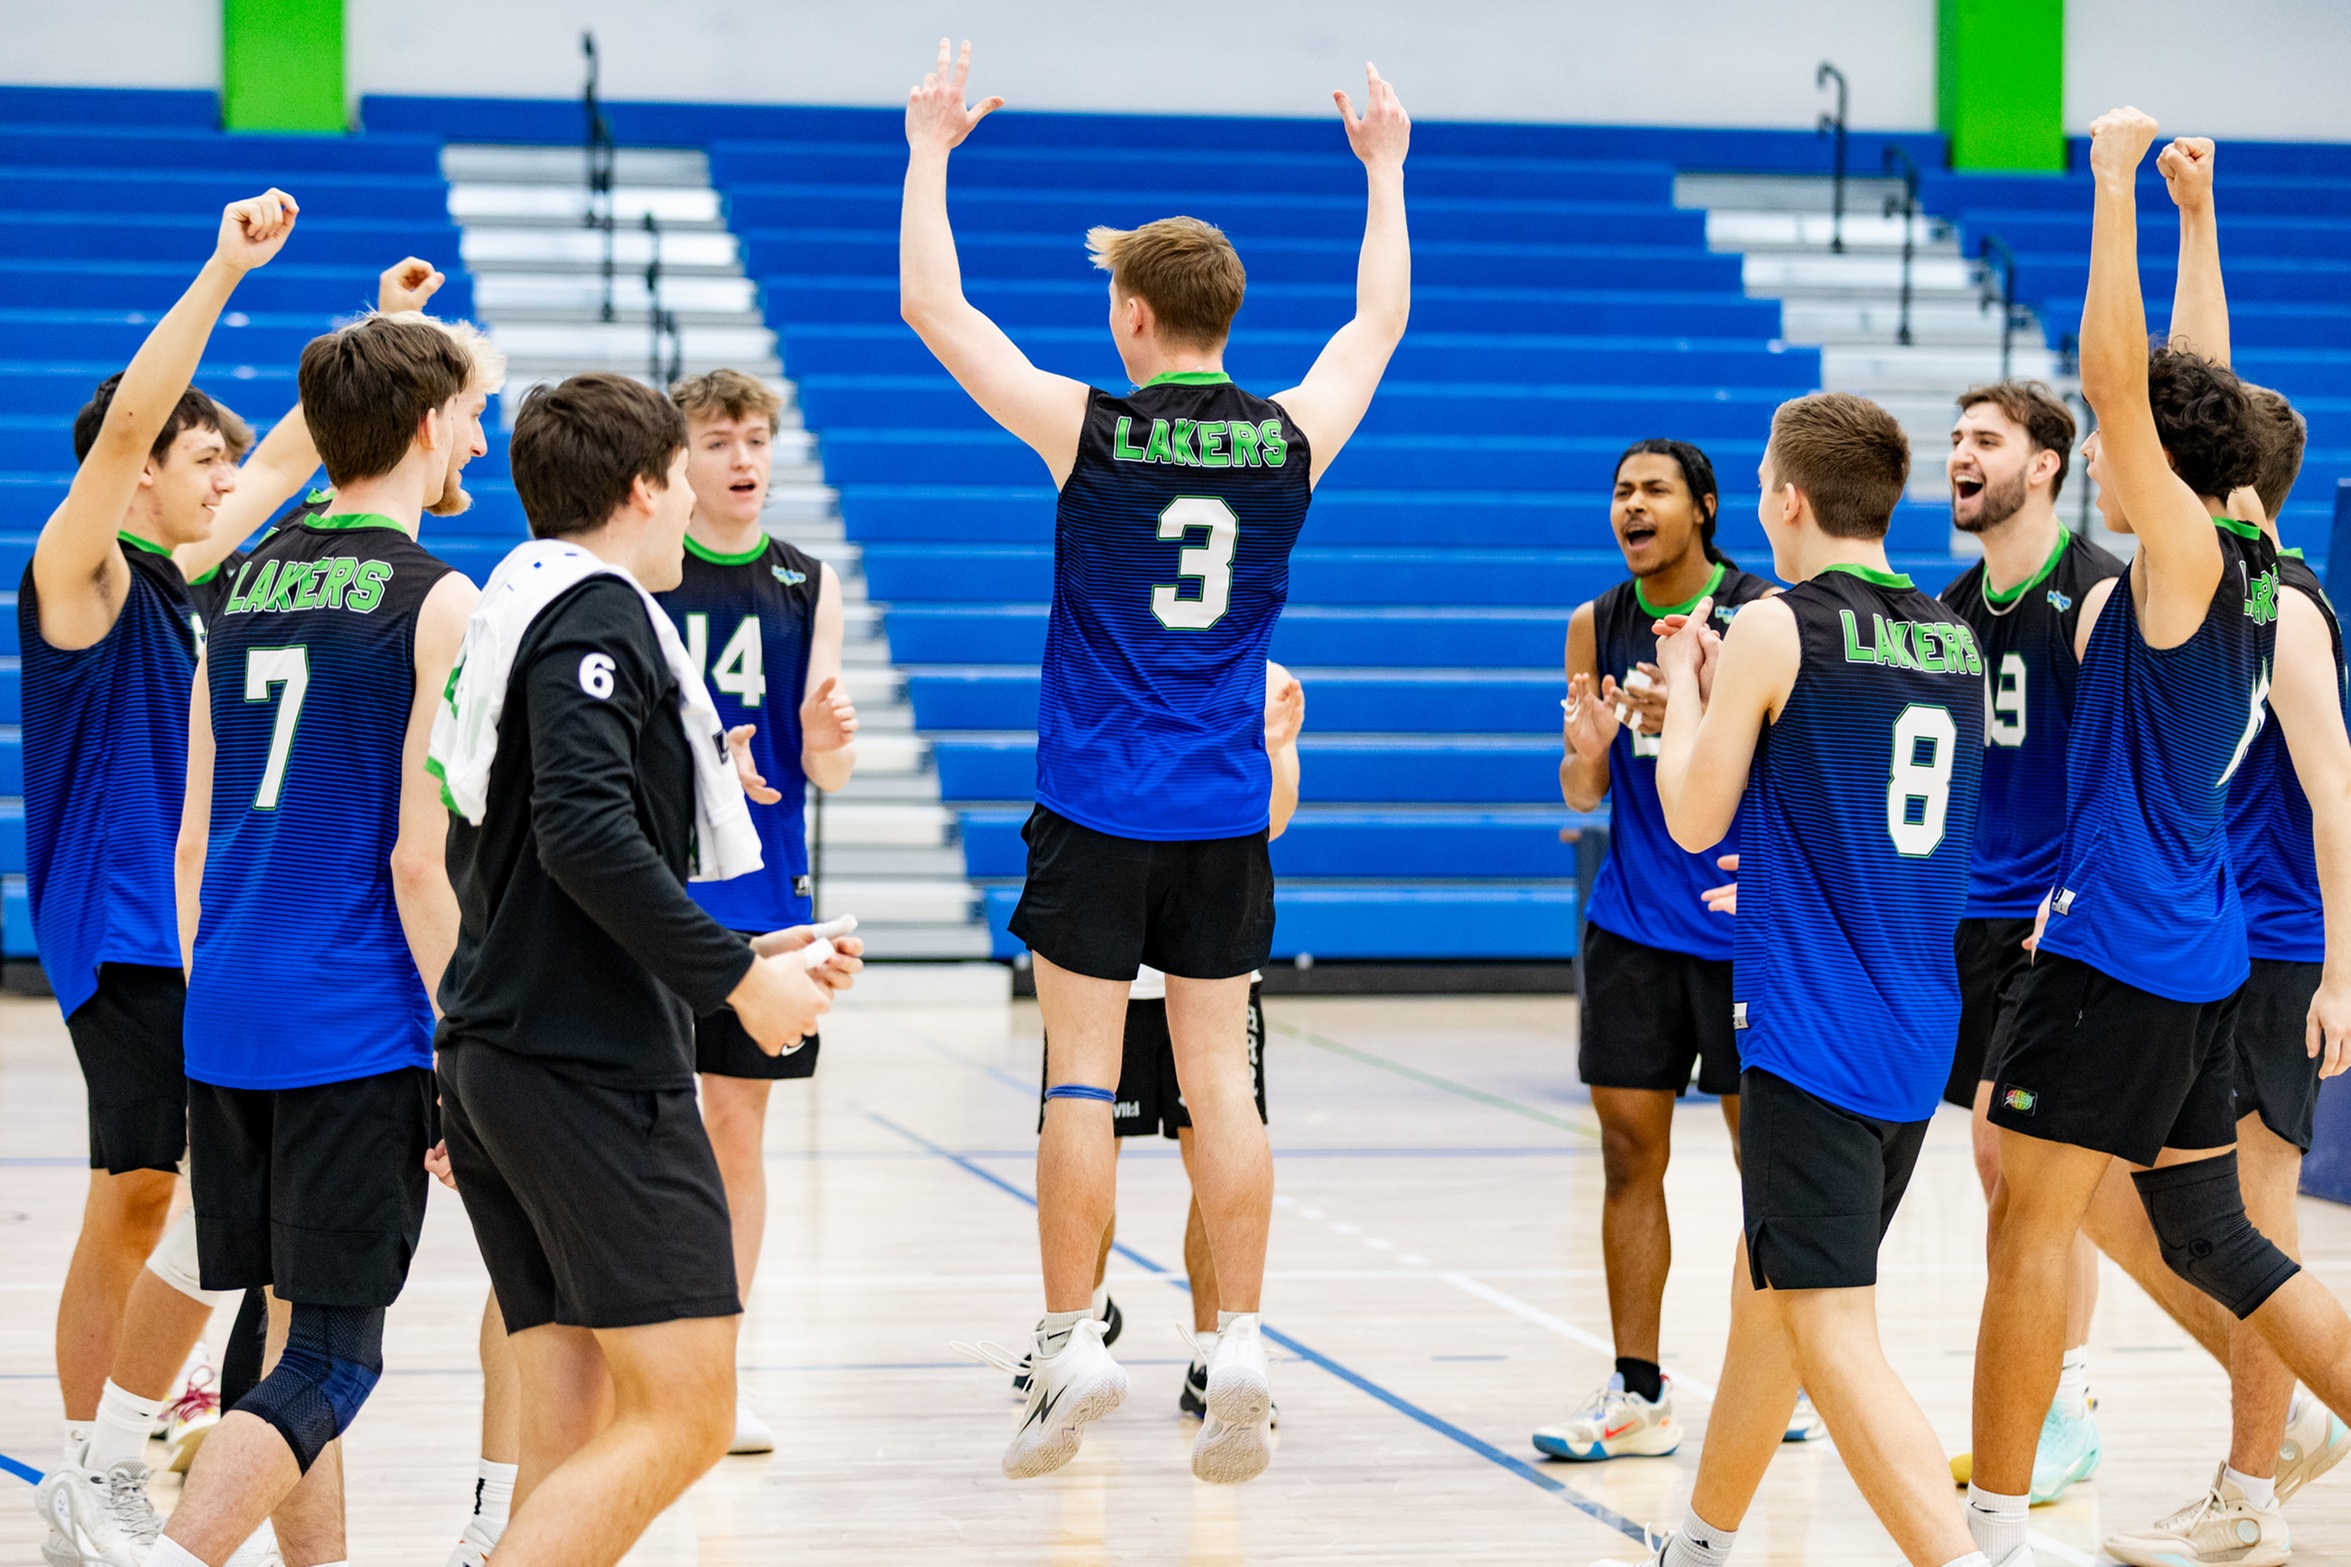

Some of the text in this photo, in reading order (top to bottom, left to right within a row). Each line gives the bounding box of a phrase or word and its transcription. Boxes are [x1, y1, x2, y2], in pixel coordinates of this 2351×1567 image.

[1113, 416, 1288, 467] LAKERS
[224, 556, 394, 615] LAKERS
[1150, 494, 1240, 631] 3
[578, 652, 616, 700] 6
[685, 611, 767, 709] 14
[1839, 609, 1983, 676] LAKERS
[244, 644, 310, 811] 7
[1886, 702, 1958, 859] 8
